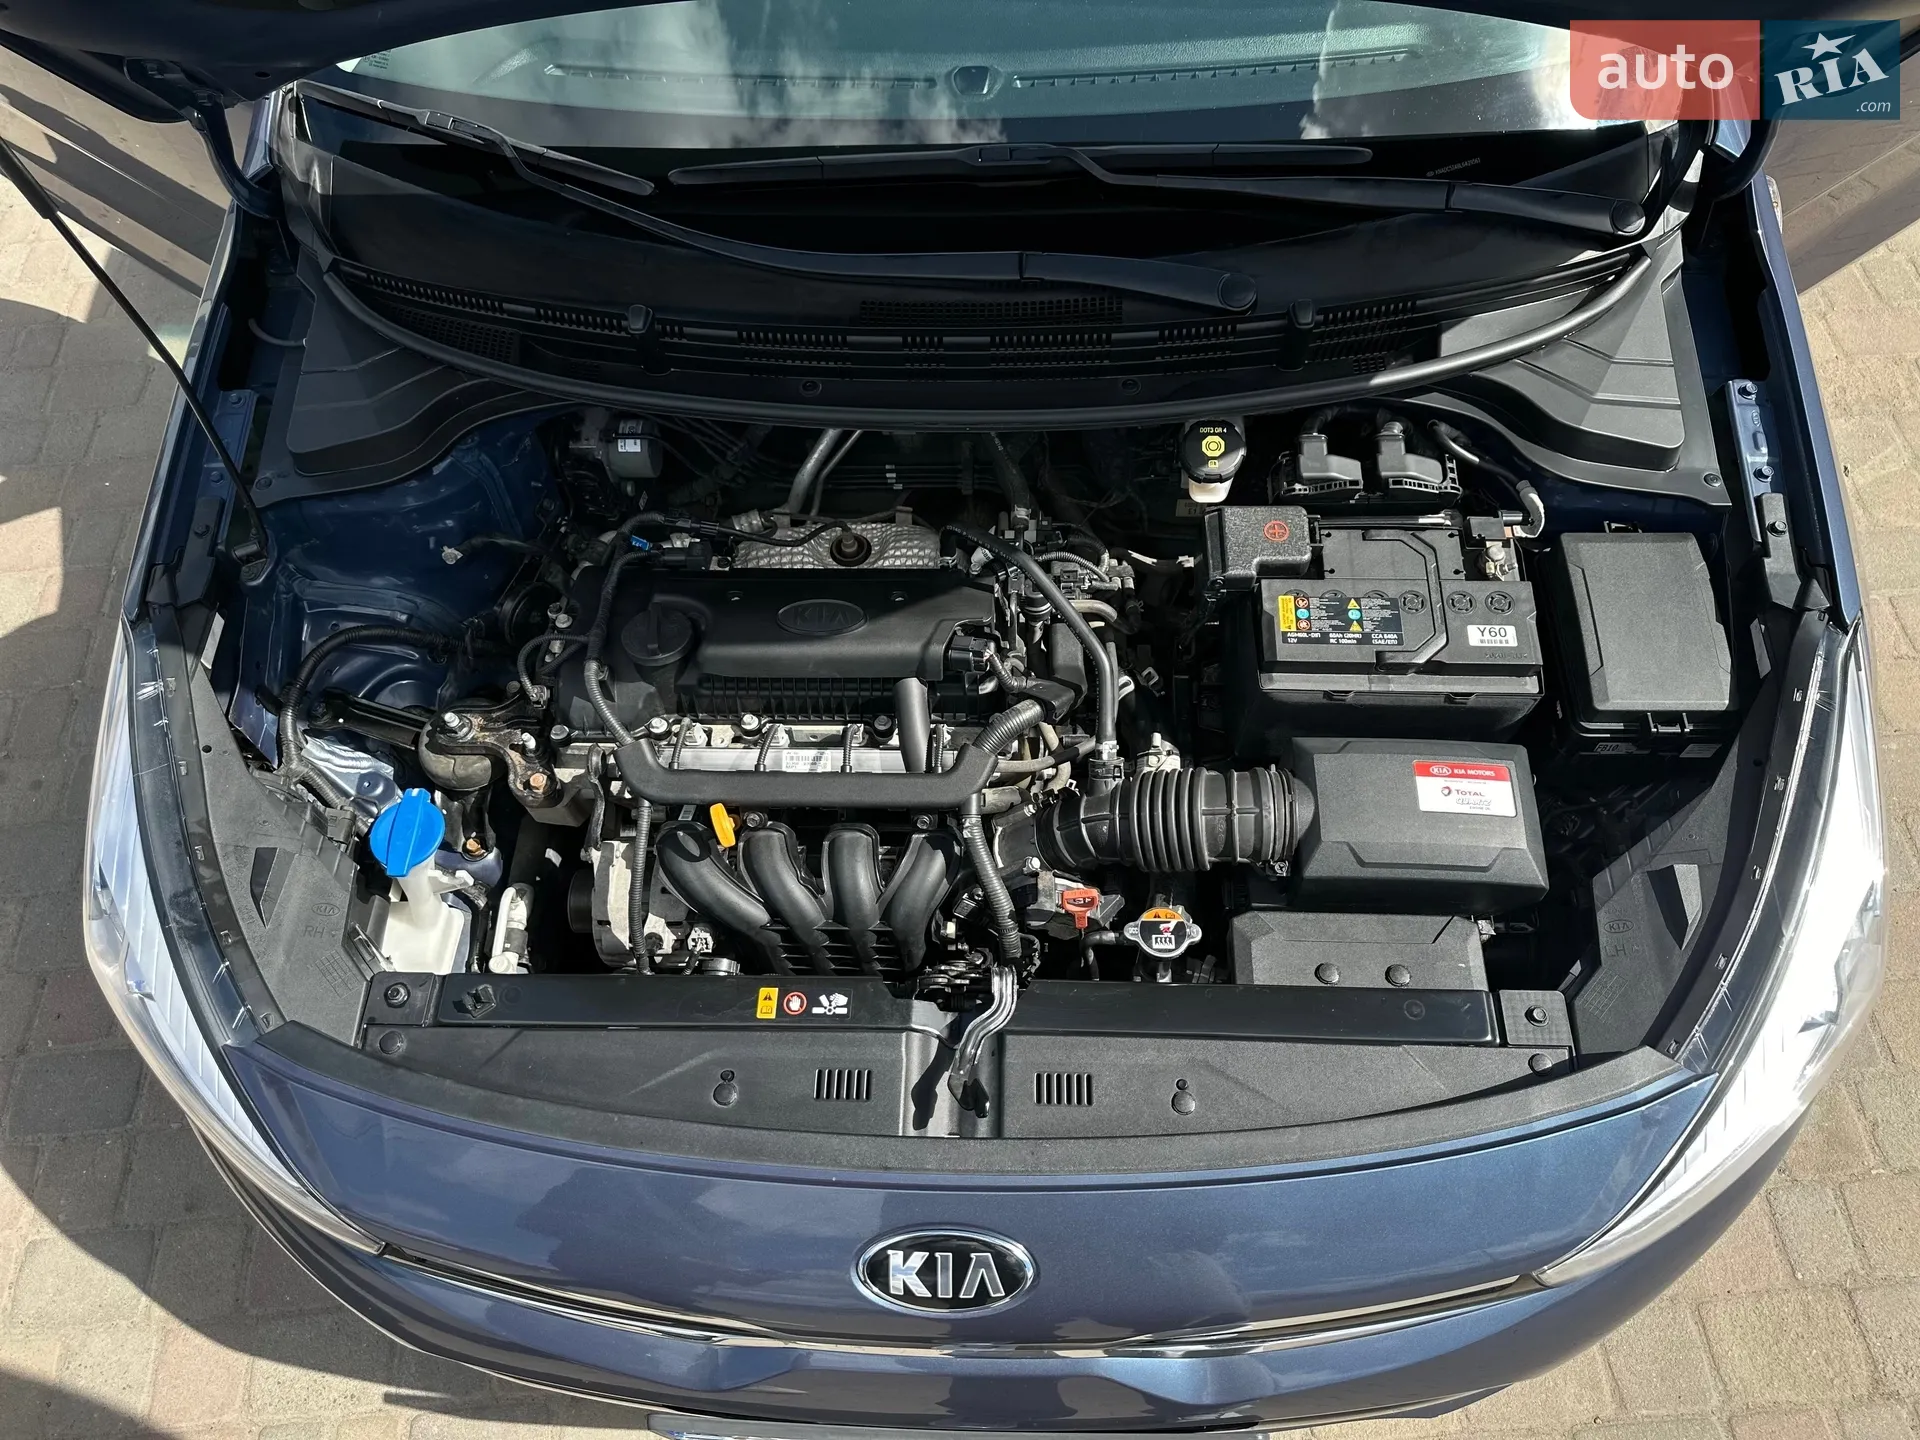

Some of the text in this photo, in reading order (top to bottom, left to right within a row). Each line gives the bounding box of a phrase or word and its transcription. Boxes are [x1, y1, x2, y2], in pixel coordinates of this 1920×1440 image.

[1476, 626, 1508, 638] Y60
[1467, 769, 1496, 777] MOTORS
[1454, 788, 1486, 797] TOTAL
[316, 905, 336, 915] KIA
[303, 925, 326, 938] RH
[1608, 922, 1630, 931] KIA
[1604, 943, 1627, 957] LH
[887, 1249, 1006, 1299] KIA
